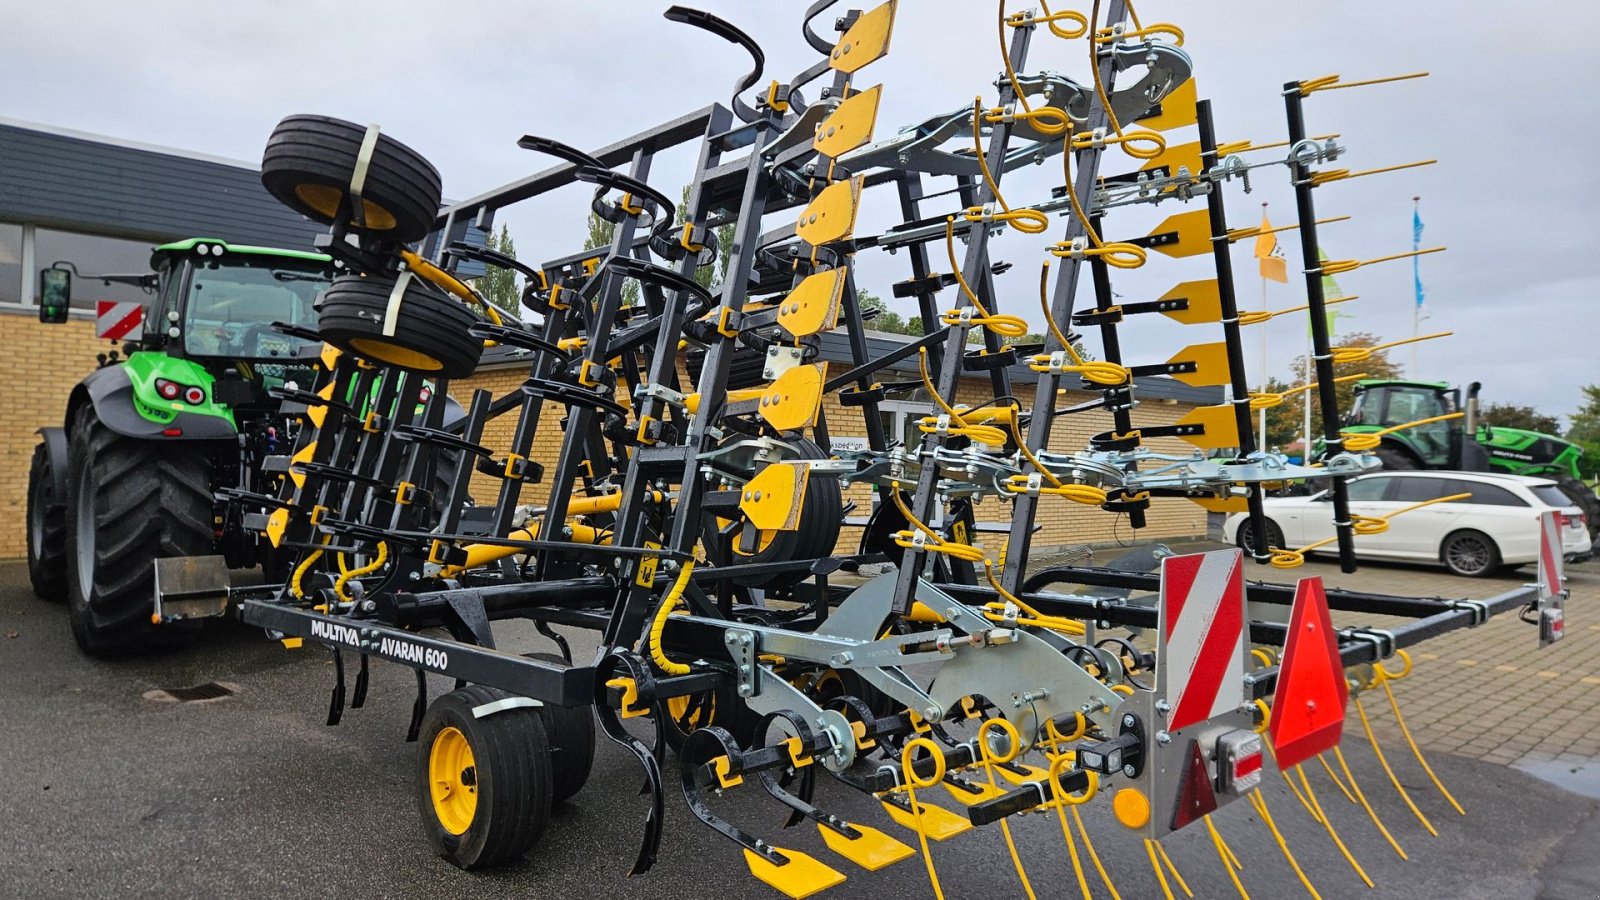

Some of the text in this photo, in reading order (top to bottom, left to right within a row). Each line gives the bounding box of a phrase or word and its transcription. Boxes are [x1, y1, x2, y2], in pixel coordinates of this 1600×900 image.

[311, 620, 448, 671] MULTIVA AVARAN 600
